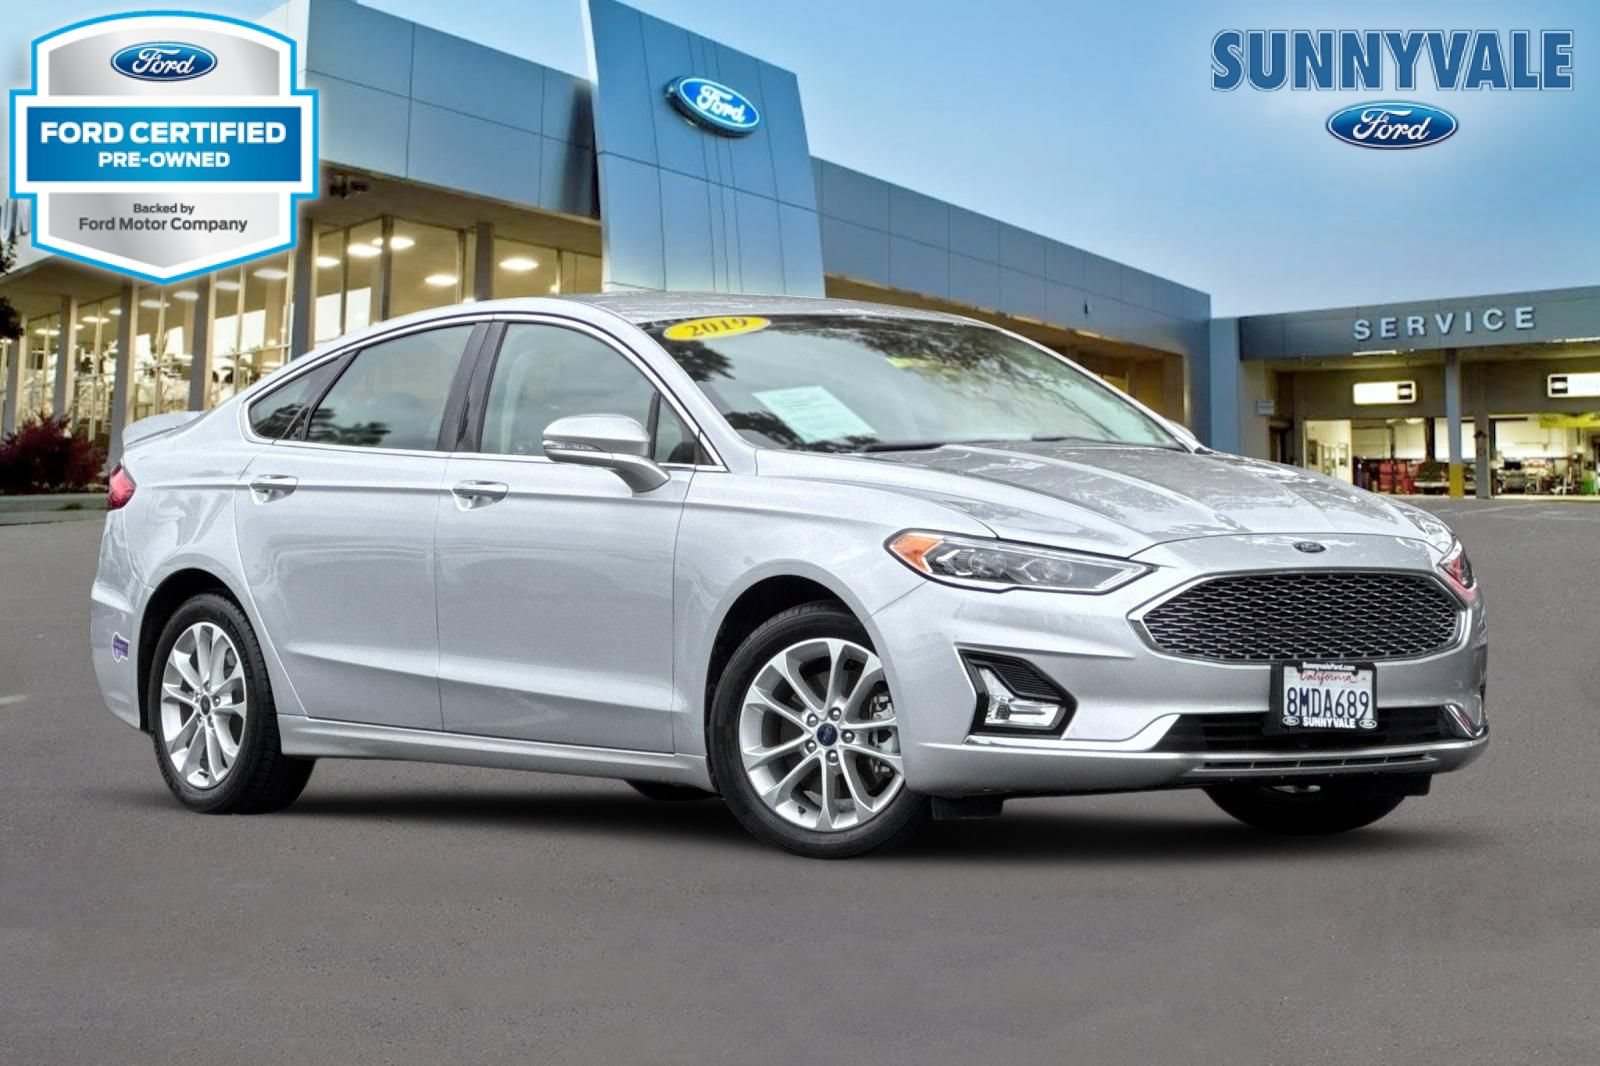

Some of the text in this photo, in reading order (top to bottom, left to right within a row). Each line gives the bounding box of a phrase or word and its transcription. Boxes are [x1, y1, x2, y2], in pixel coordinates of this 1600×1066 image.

[696, 85, 746, 123] Ford
[684, 317, 748, 337] 2019
[1353, 306, 1535, 341] SERVICE
[1300, 671, 1357, 685] California
[1287, 687, 1370, 719] 8MDA689
[1303, 717, 1356, 728] SUNNYVALE
